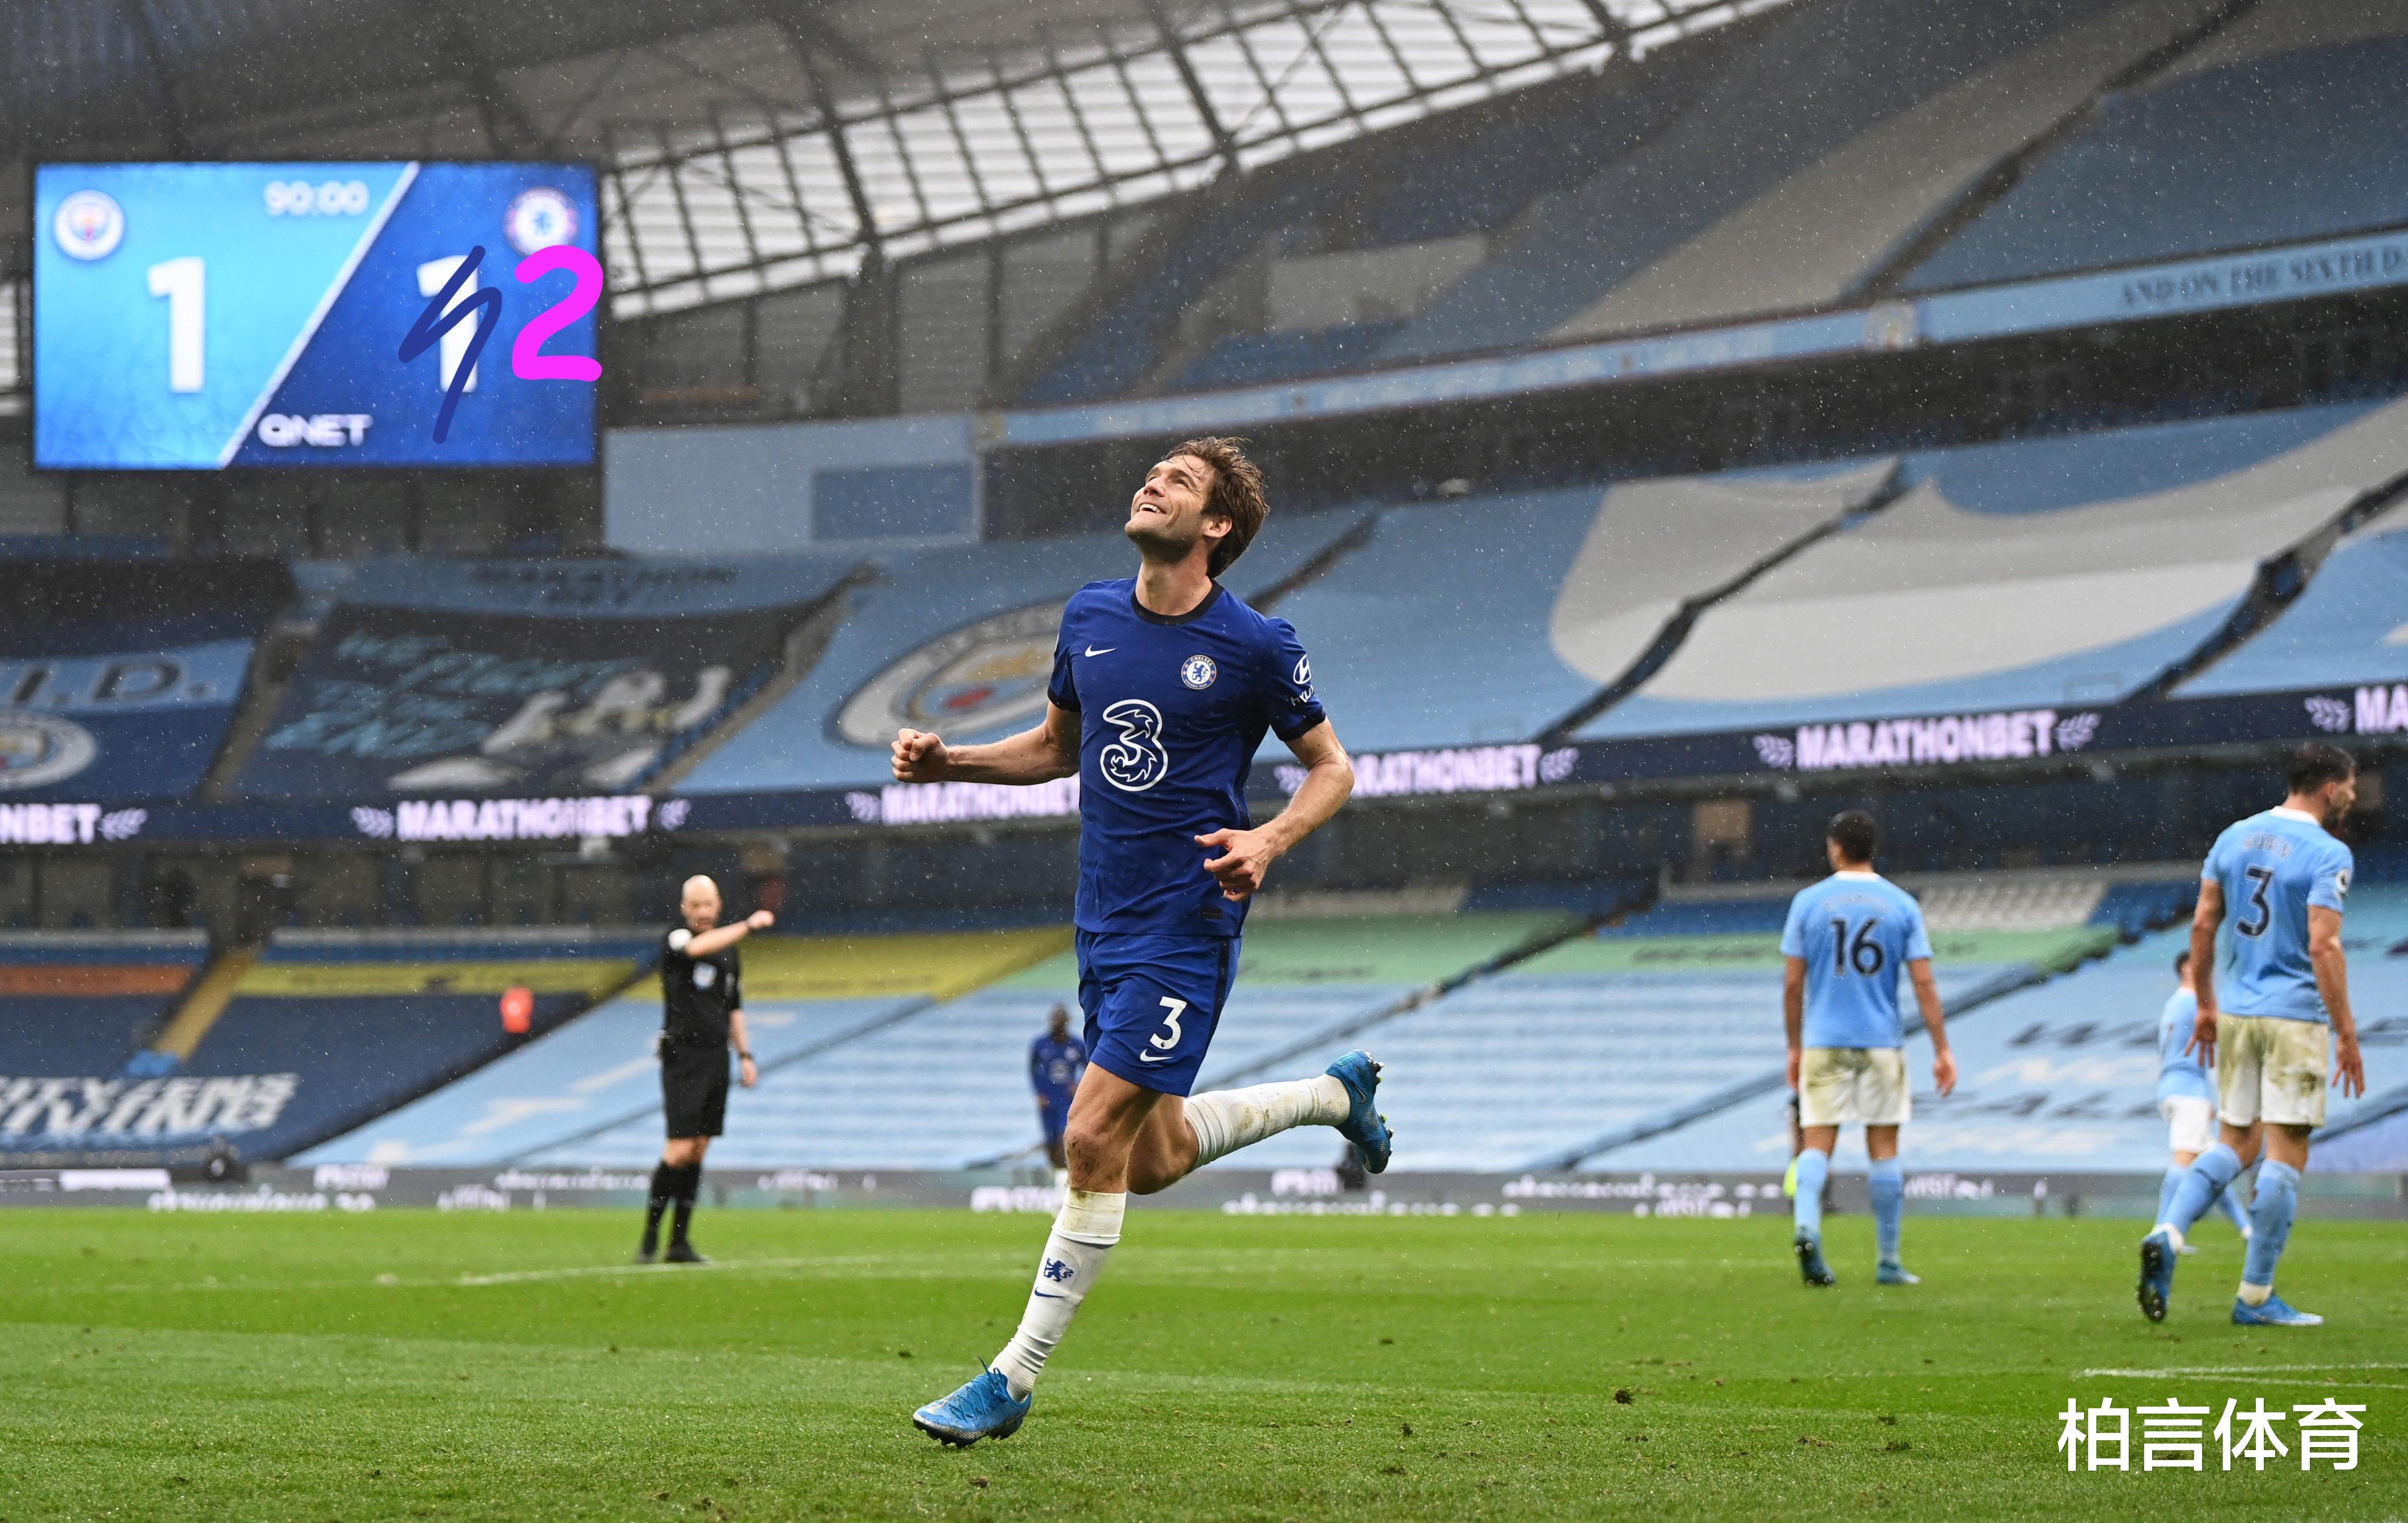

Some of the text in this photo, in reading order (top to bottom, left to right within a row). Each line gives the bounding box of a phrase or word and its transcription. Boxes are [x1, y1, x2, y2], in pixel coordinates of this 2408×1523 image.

[263, 180, 370, 216] 90:00
[146, 256, 205, 393] 1
[416, 255, 479, 393] 1
[257, 413, 373, 447] QNET
[1190, 656, 1213, 667] CHELSEA
[1796, 708, 2056, 769] MARATHONBET
[1352, 743, 1541, 798] RATHONBET
[2236, 863, 2275, 940] 3
[1830, 916, 1885, 976] 16
[1149, 996, 1188, 1050] 3
